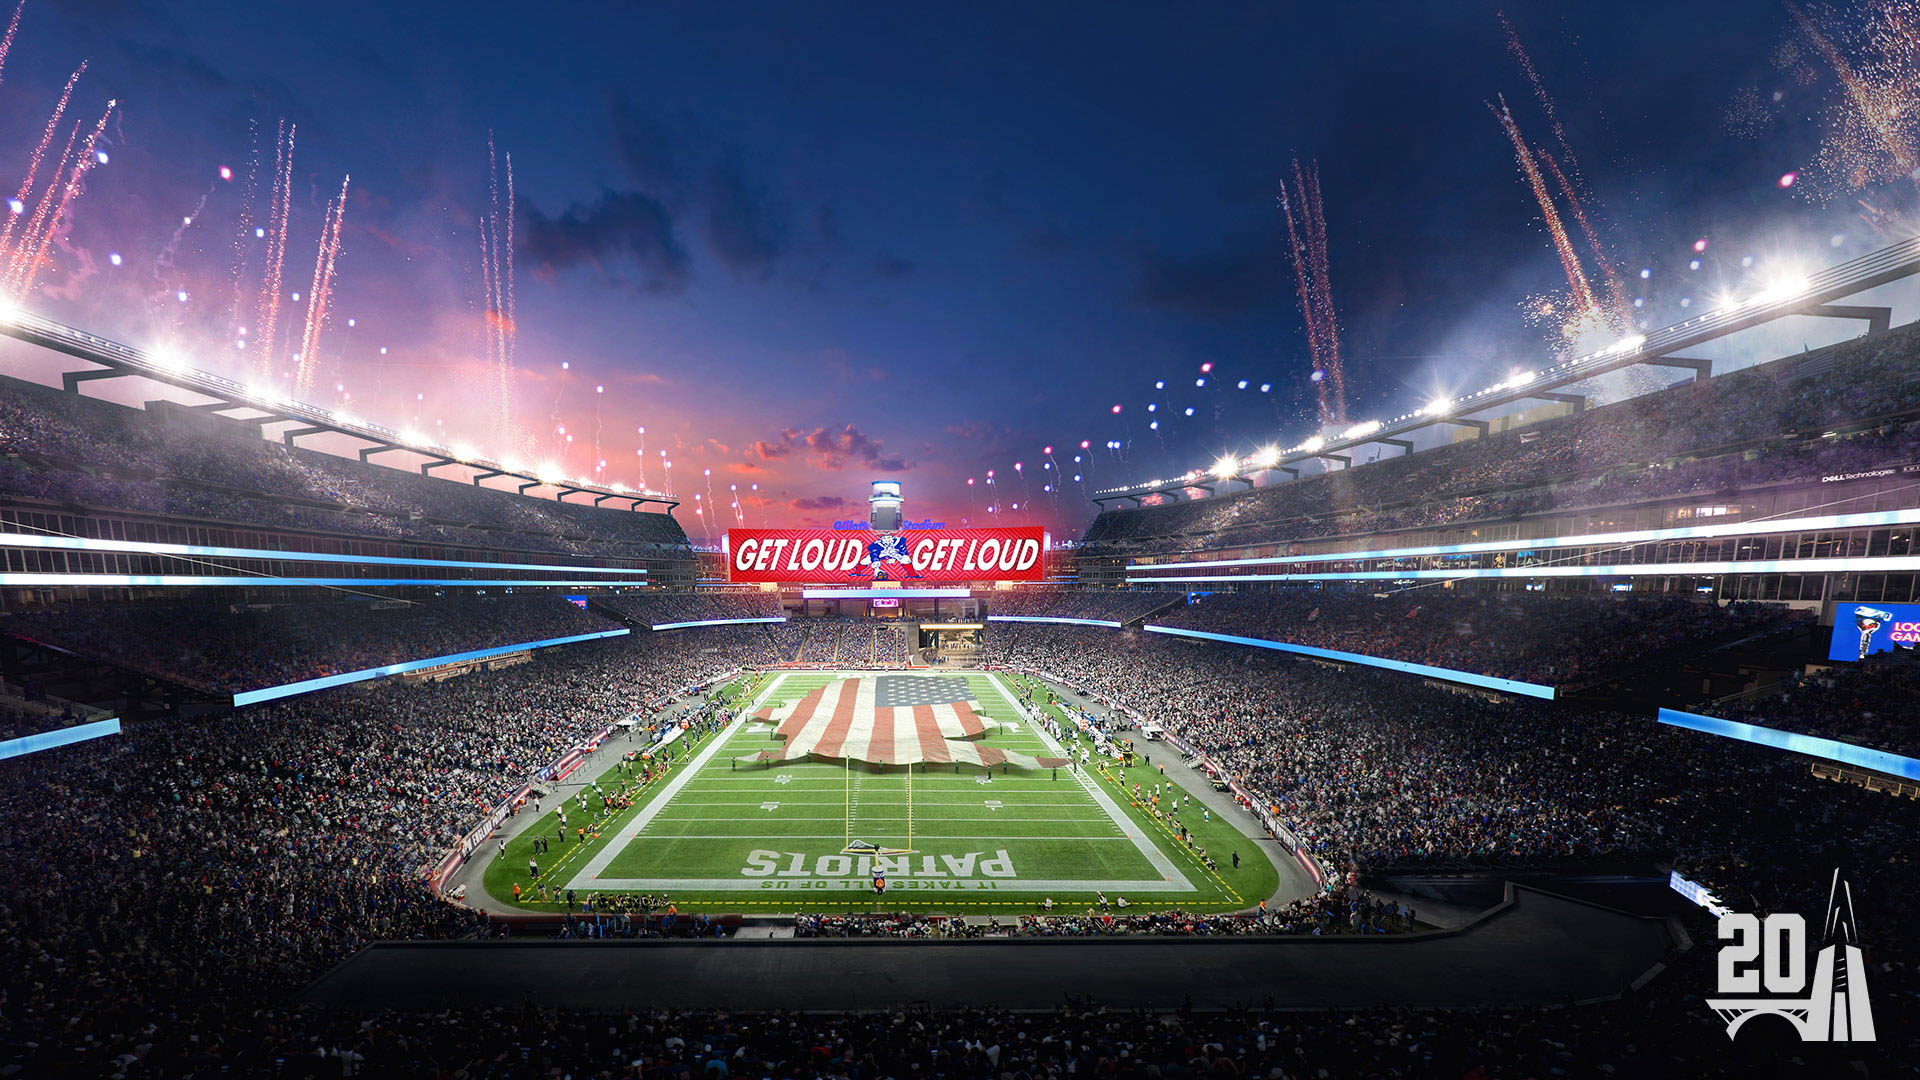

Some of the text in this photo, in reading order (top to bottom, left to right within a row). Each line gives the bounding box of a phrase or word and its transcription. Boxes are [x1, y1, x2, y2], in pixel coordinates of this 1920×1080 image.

[1822, 474, 1845, 483] DELL
[1845, 469, 1896, 480] Technologies
[902, 519, 945, 530] Stadium
[736, 539, 863, 571] GET LOUD
[912, 539, 1039, 571] GET LOUD
[740, 849, 1017, 877] PATRIOTS
[760, 880, 789, 889] US
[799, 880, 828, 889] OF
[892, 880, 965, 889] TAKES
[977, 880, 998, 889] IT
